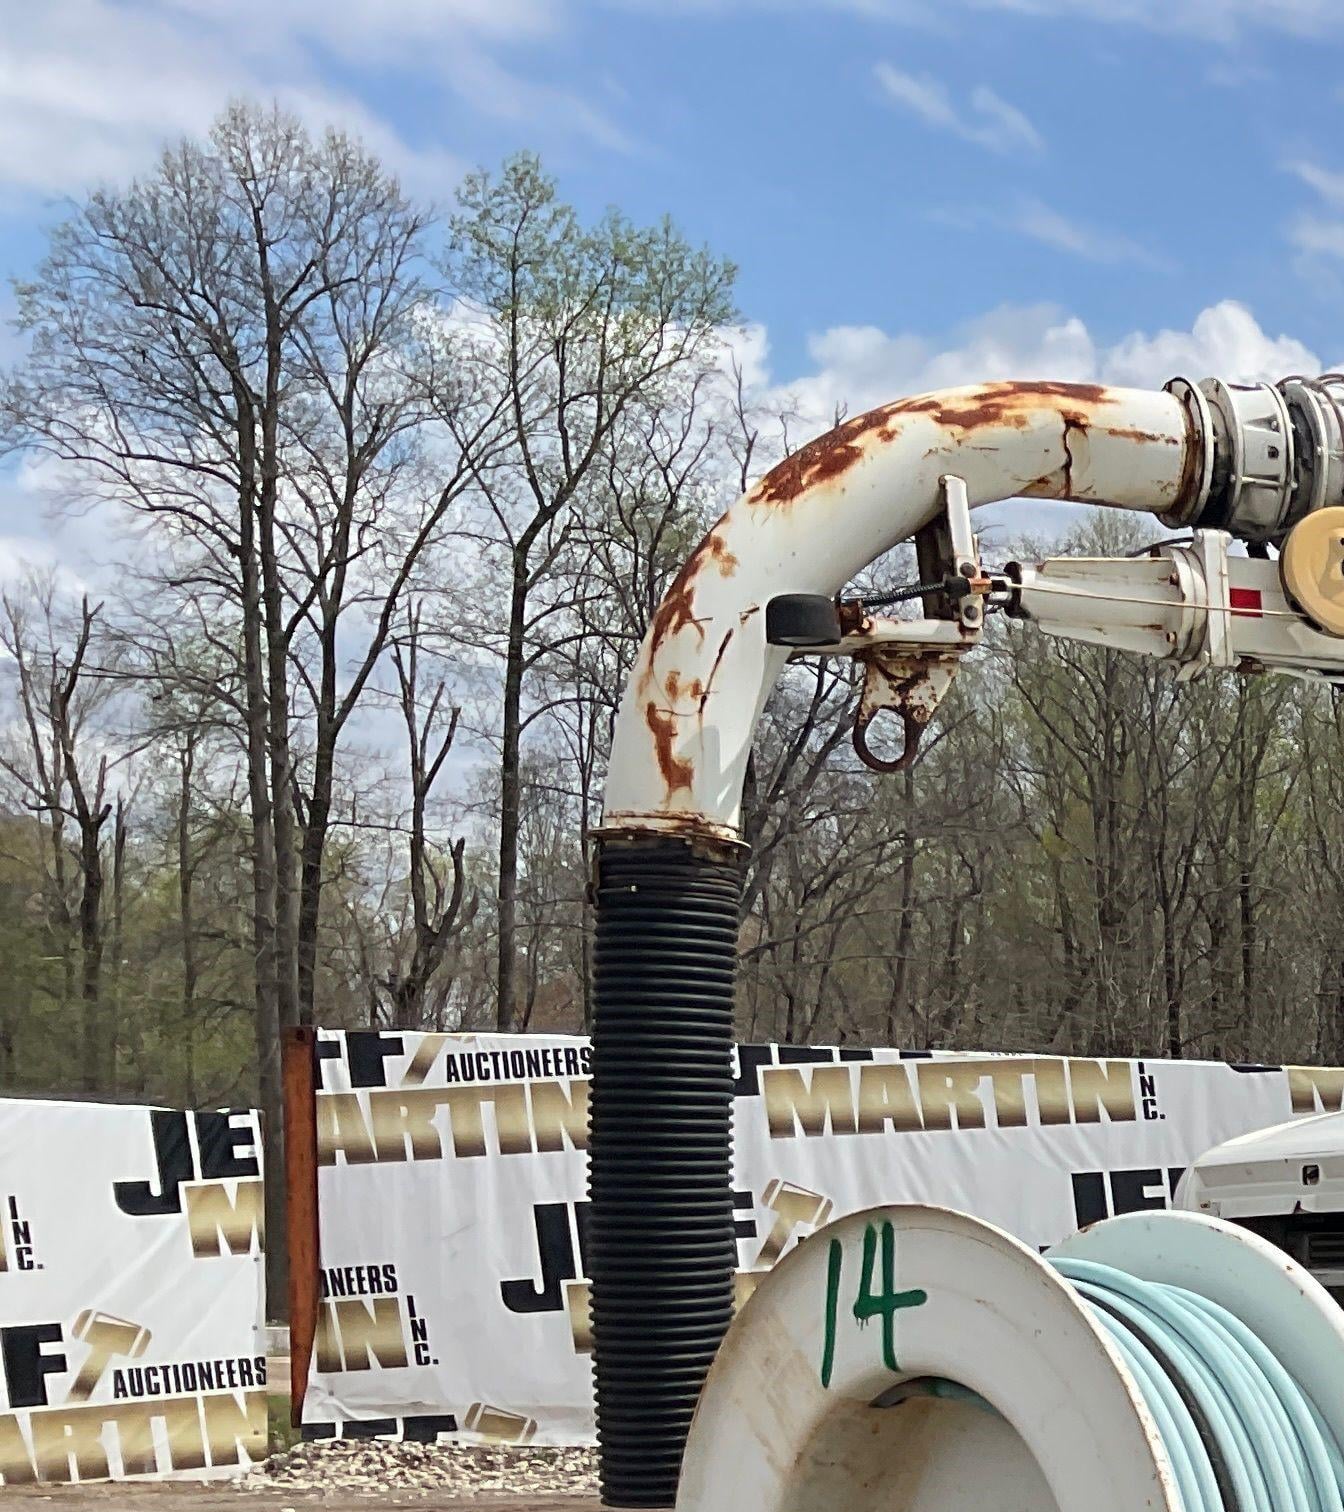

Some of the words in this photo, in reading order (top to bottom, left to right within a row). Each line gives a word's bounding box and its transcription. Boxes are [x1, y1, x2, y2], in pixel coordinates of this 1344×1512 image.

[446, 1047, 594, 1082] AUCTIONEERS
[763, 1058, 1137, 1138] MARTIN
[1137, 1061, 1166, 1120] INC.
[316, 1081, 592, 1166] ARTIN
[8, 1196, 44, 1271] INC.
[407, 1295, 439, 1366] INC.
[821, 1220, 928, 1389] 14
[113, 1356, 267, 1399] AUCTIONEERS
[0, 1391, 268, 1486] ARTIN
